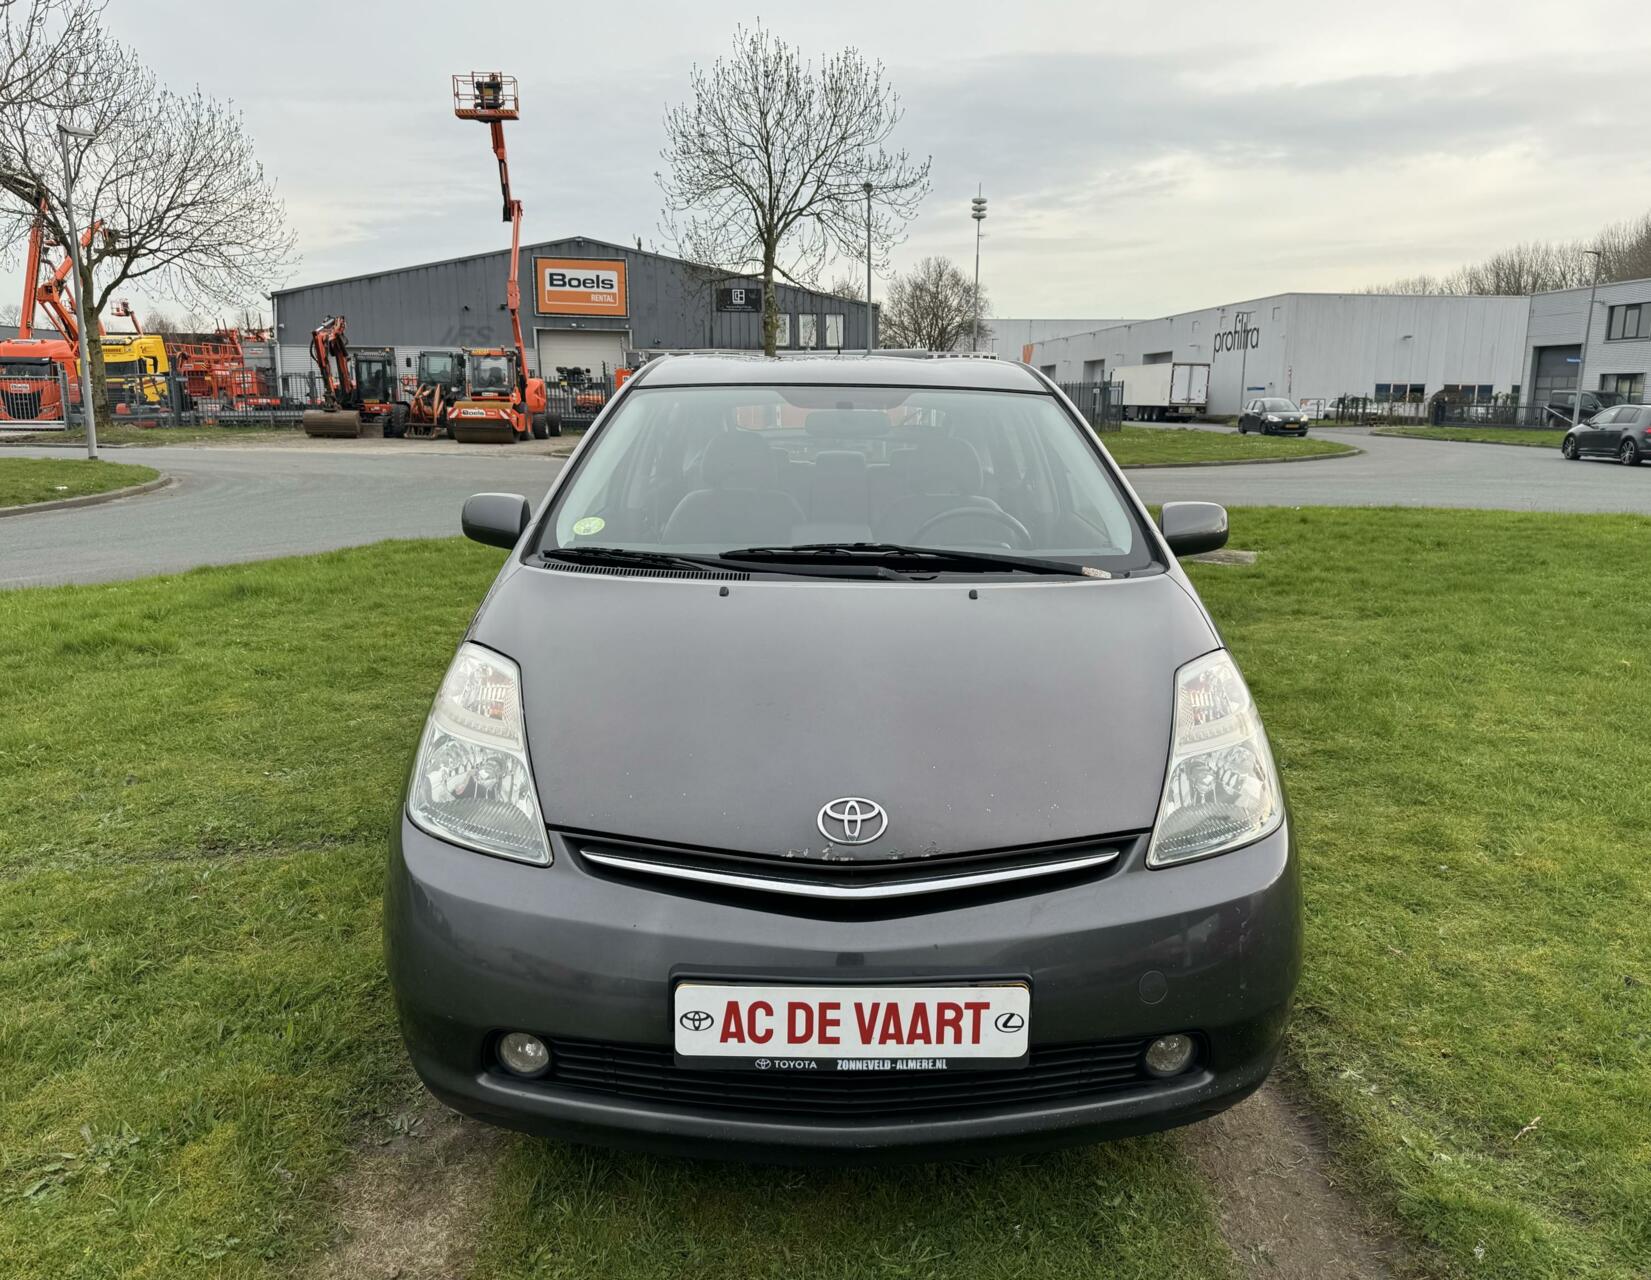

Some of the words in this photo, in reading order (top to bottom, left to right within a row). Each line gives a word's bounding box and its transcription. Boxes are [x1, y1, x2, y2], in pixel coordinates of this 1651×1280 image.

[548, 272, 615, 290] Boels
[591, 293, 615, 303] RENTAL
[1212, 312, 1260, 363] profiltra
[719, 1000, 774, 1044] AC
[787, 1001, 841, 1045] DE
[854, 1001, 991, 1045] VAART
[774, 1060, 818, 1069] TOYOTA
[836, 1059, 948, 1071] ZONNEVELD-ALMERE.NL
